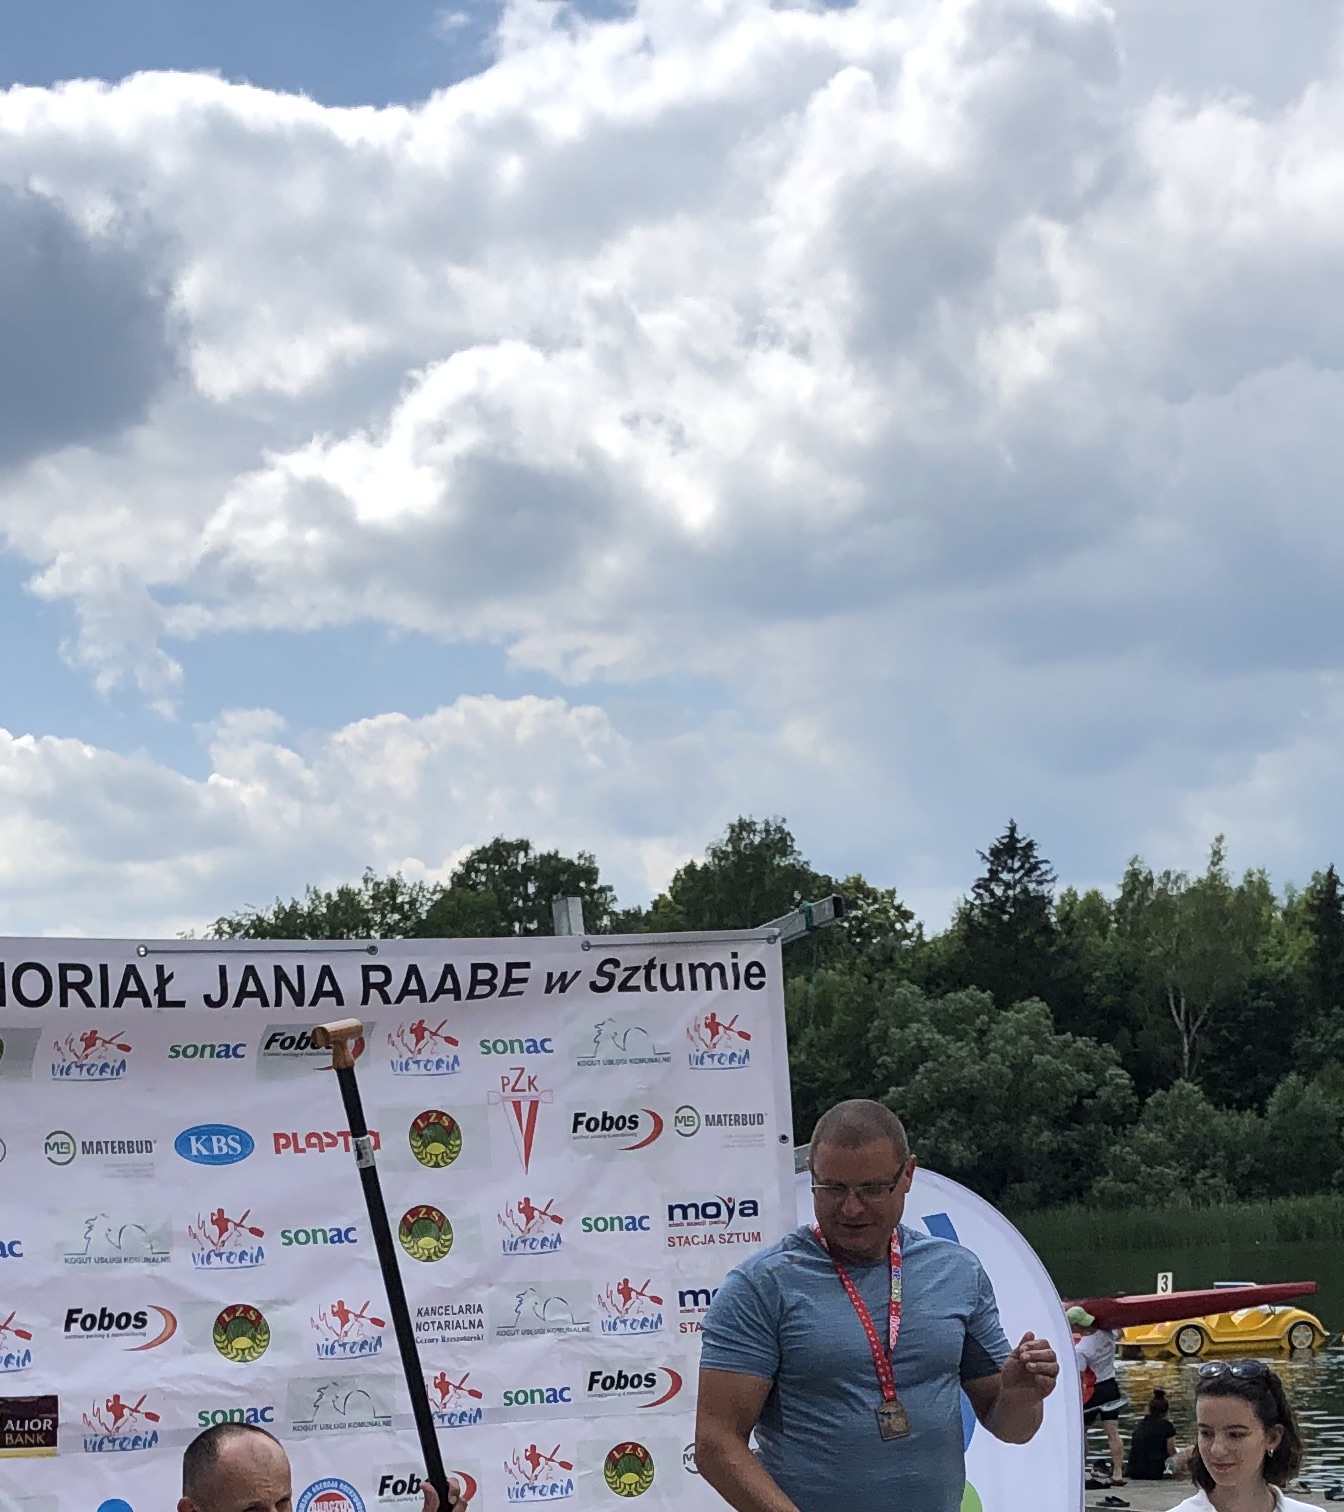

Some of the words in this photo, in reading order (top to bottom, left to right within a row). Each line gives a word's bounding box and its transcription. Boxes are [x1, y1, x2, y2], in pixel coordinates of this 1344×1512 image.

[203, 964, 345, 1009] JANA
[360, 961, 531, 1006] RAABE
[544, 970, 581, 994] w
[589, 952, 767, 994] Sztumie
[264, 1031, 333, 1051] Fob
[479, 1037, 554, 1056] sonac
[168, 1042, 247, 1060] sonac
[501, 1068, 538, 1092] PZK
[417, 1113, 450, 1128] LZS
[572, 1111, 639, 1134] Fobos
[705, 1113, 764, 1127] MATERBUD
[81, 1140, 154, 1155] MATERBUD
[189, 1135, 241, 1156] KBS
[406, 1207, 441, 1222] LZS
[668, 1195, 759, 1230] moya
[582, 1214, 650, 1232] sonac
[281, 1226, 358, 1246] sonac
[667, 1234, 716, 1248] STACJA
[719, 1232, 762, 1245] SZTUM
[1160, 1275, 1170, 1294] 3
[64, 1307, 147, 1332] Fobos
[222, 1306, 256, 1321] LZS
[416, 1304, 484, 1318] KANCELARIA
[415, 1319, 484, 1332] NOTARIALNA
[588, 1369, 656, 1391] Fobos
[504, 1386, 571, 1406] sonac
[4, 1419, 53, 1431] ALIOR
[198, 1406, 274, 1427] sonac
[6, 1432, 47, 1445] BANK
[613, 1444, 644, 1458] LZS
